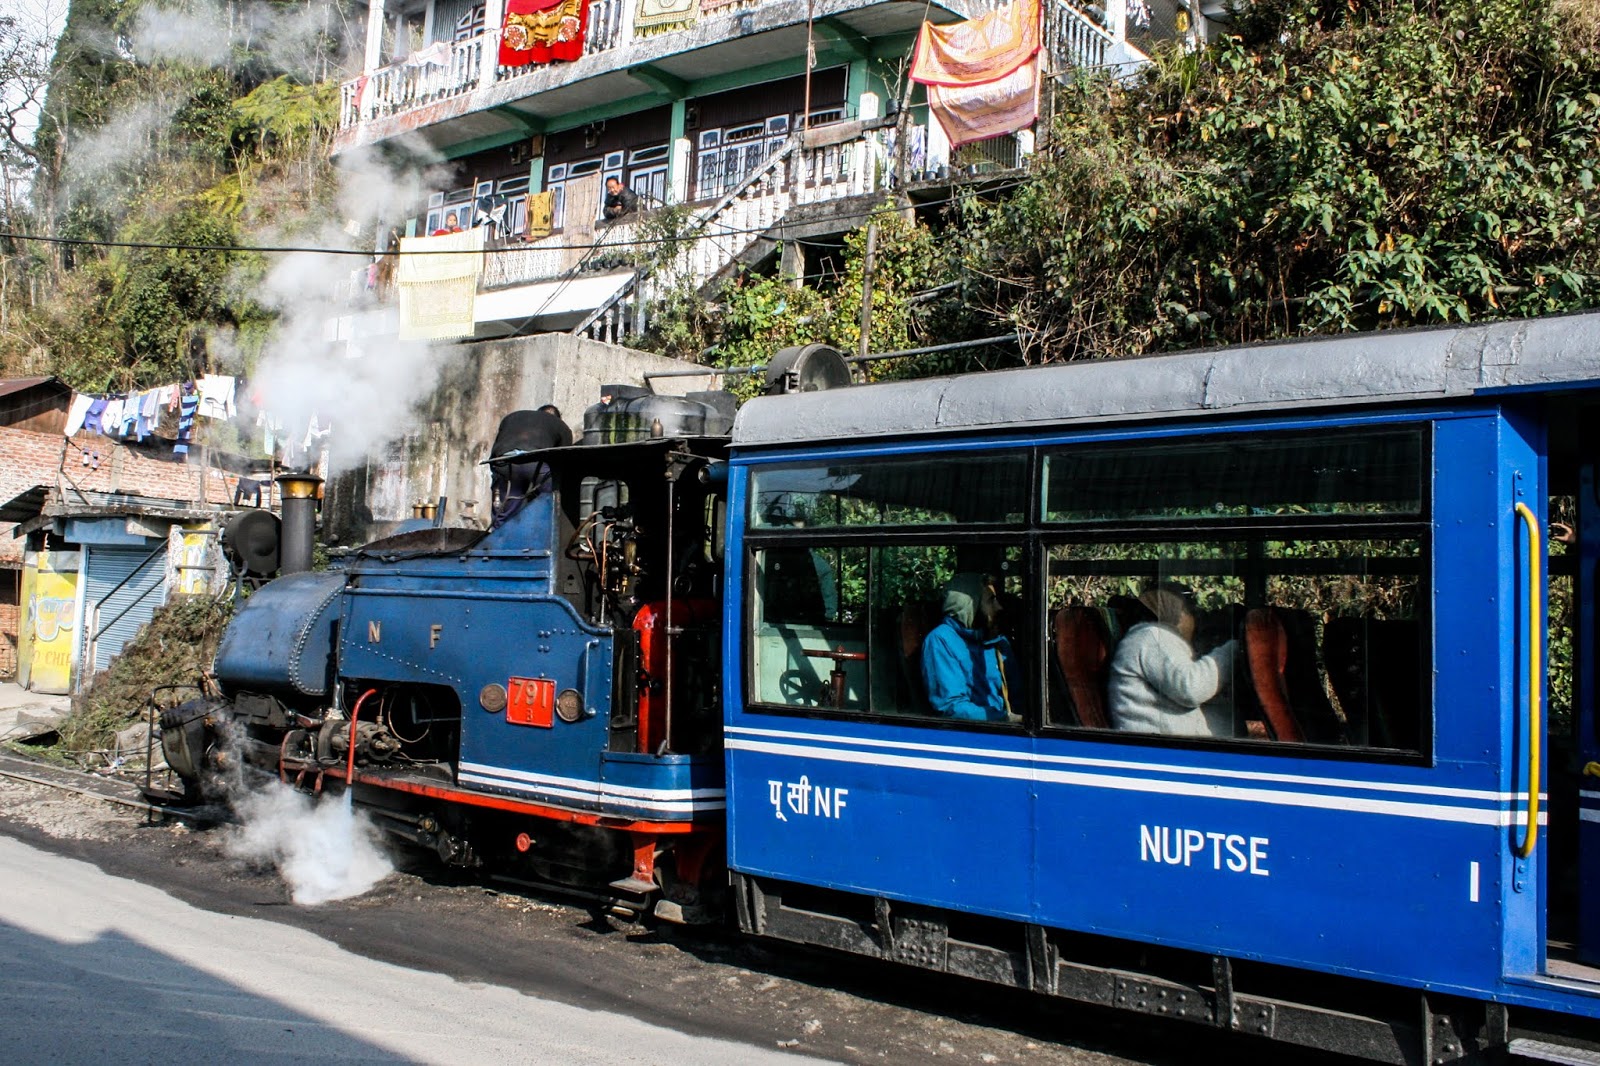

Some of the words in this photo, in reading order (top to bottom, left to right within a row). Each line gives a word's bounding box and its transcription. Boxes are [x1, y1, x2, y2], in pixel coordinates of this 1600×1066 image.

[514, 679, 548, 708] 791
[814, 785, 849, 819] NF
[1140, 824, 1270, 876] NUPTSE
